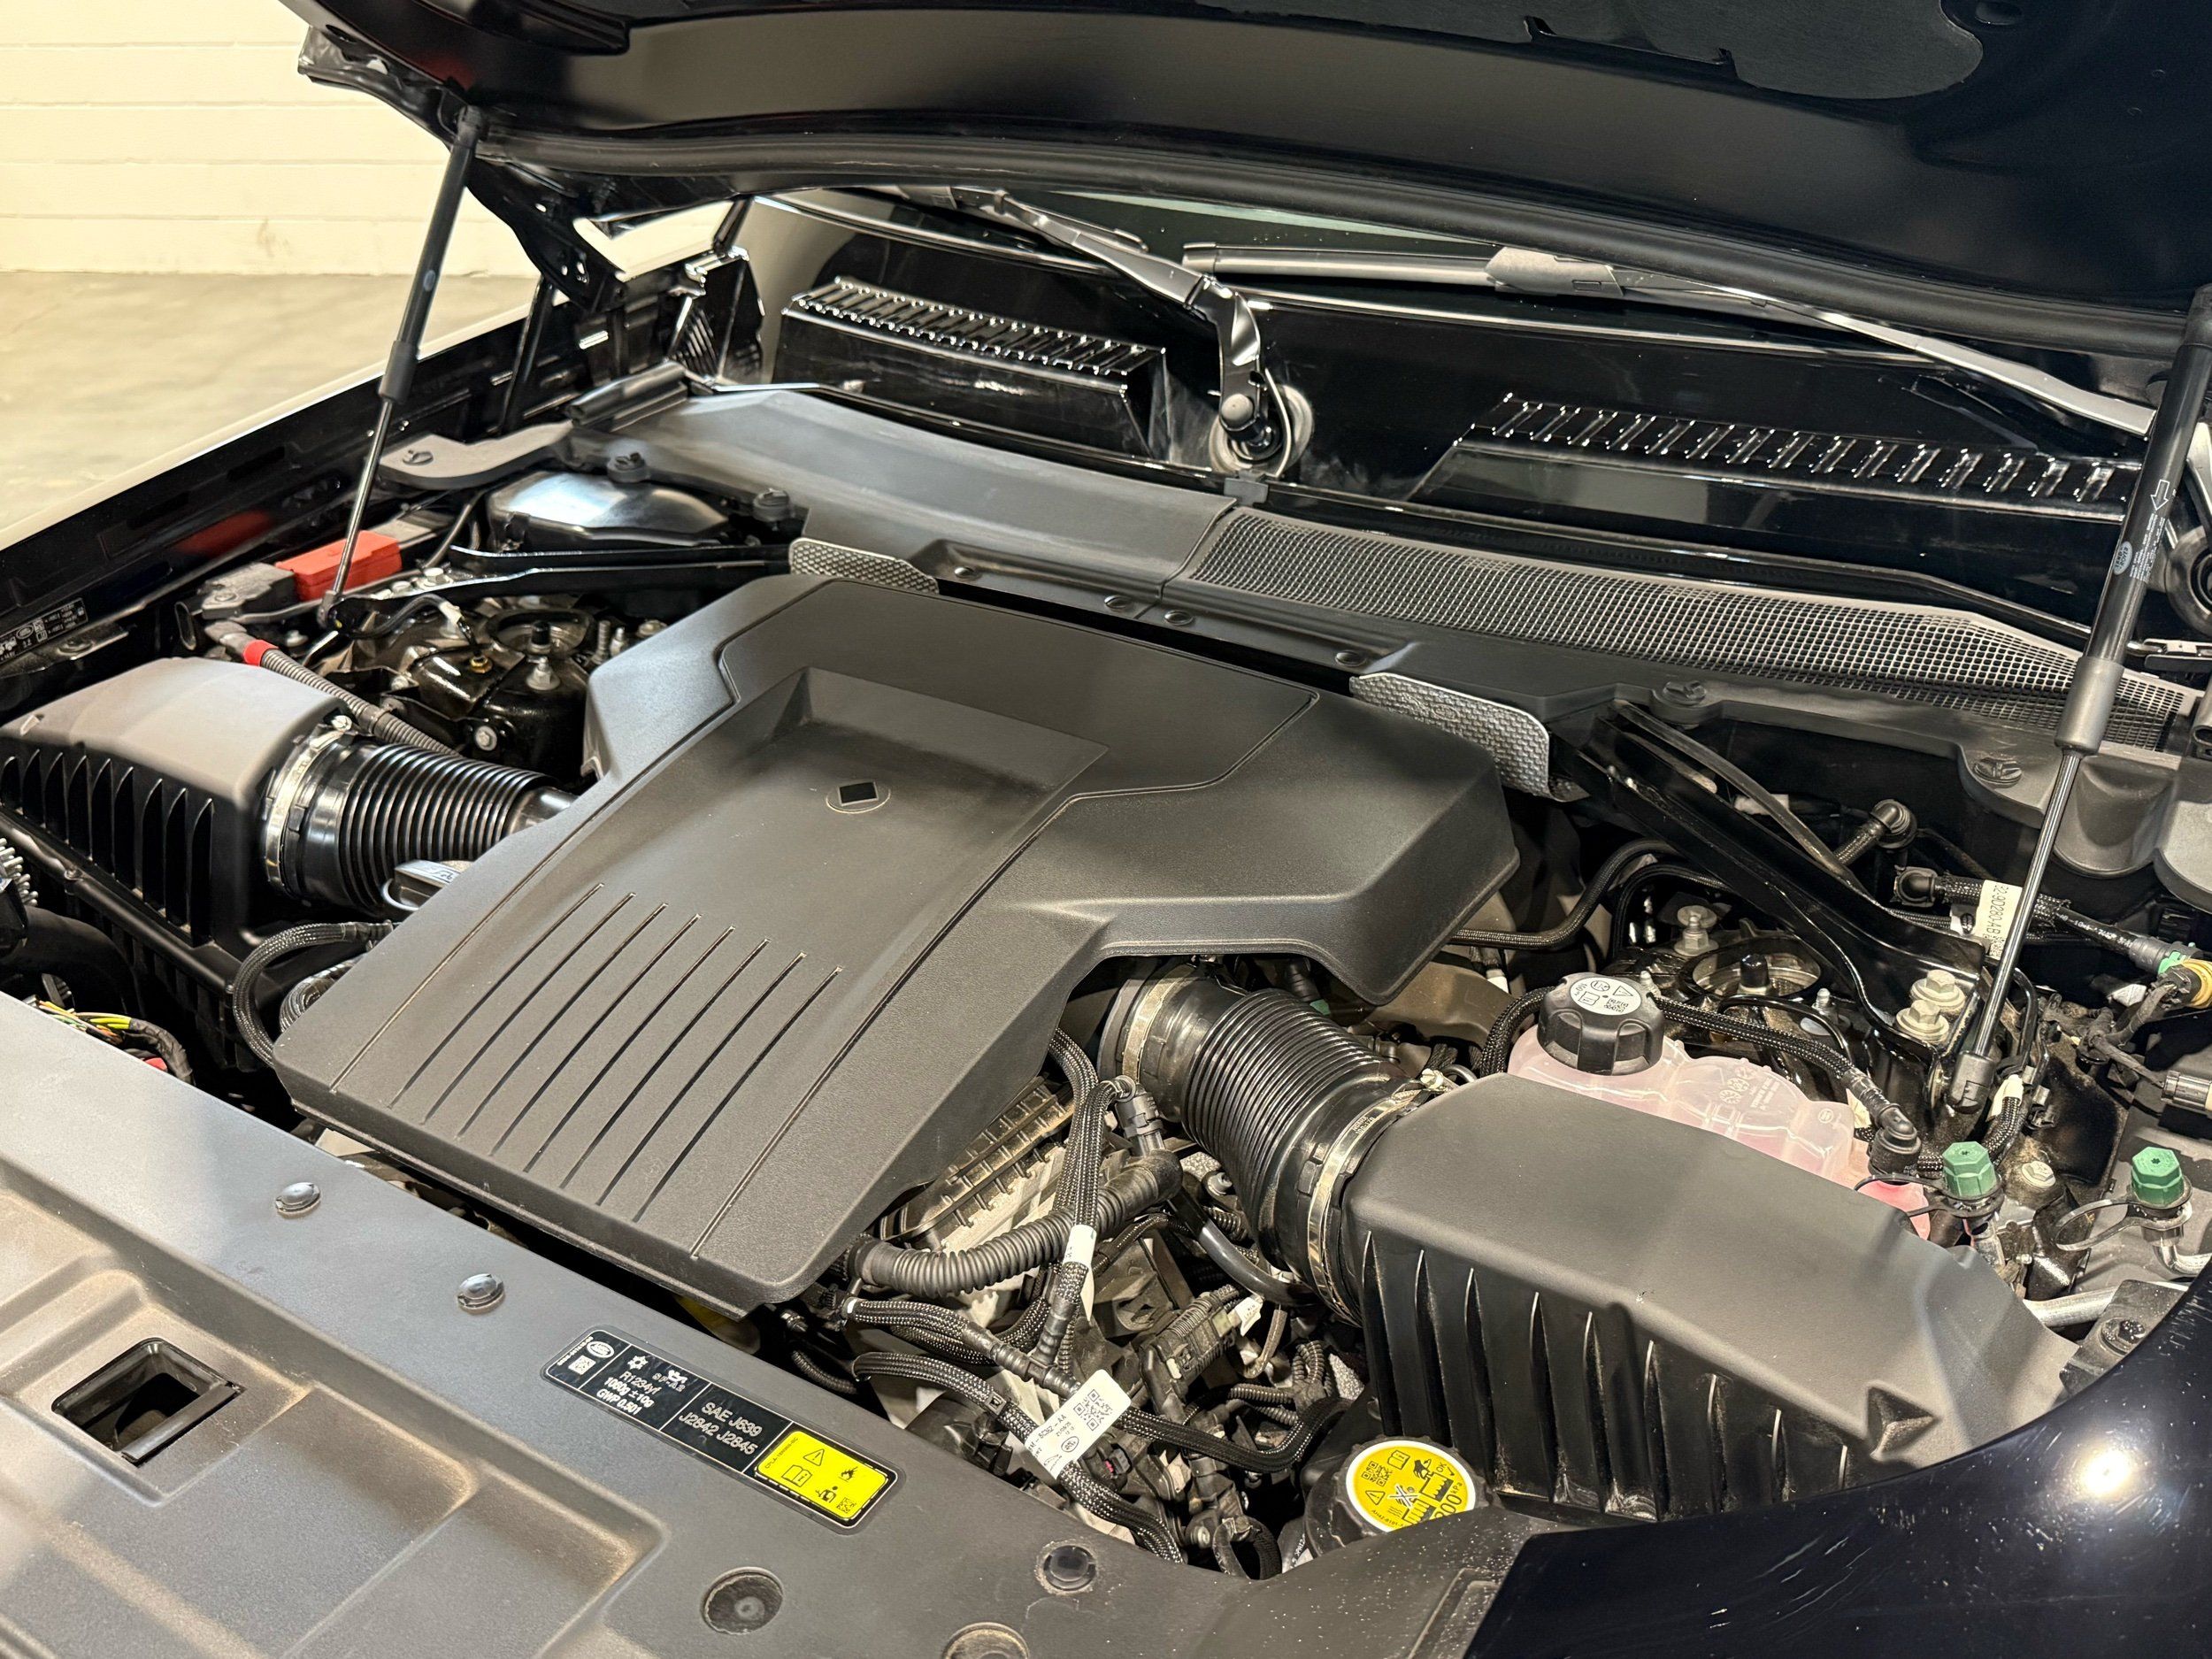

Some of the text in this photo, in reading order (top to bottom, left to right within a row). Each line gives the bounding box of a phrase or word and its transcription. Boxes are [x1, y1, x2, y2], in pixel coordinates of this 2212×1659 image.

[619, 1371, 662, 1395] R1234yf
[596, 1388, 642, 1415] GWP 0.501
[702, 1402, 763, 1437] SAE J639
[679, 1411, 758, 1455] J2842 J2845
[1436, 1461, 1447, 1473] OK
[1450, 1482, 1463, 1495] kPa
